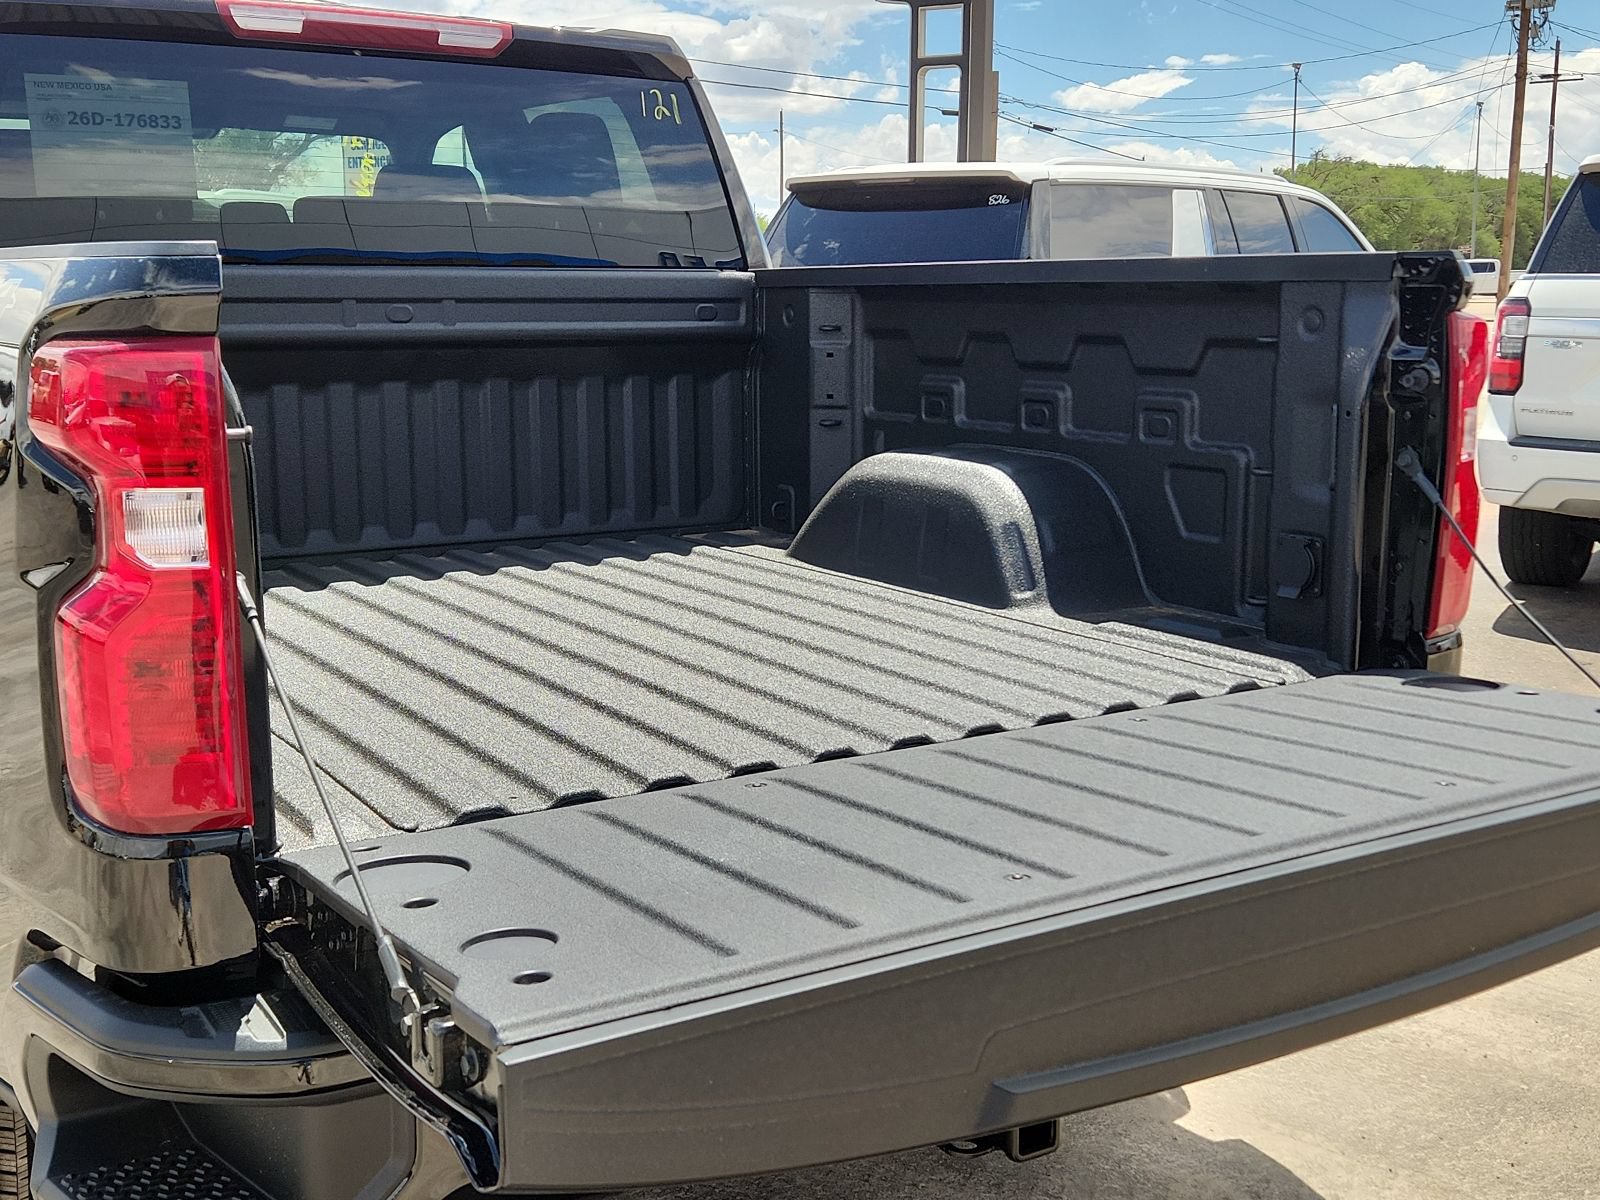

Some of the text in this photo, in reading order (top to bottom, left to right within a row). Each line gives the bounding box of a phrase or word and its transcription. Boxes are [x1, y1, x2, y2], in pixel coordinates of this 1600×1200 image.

[33, 80, 113, 92] NEW MEXICO USA
[641, 89, 682, 125] 121
[67, 110, 183, 130] 26D-176833
[350, 138, 387, 151] SRICE
[347, 155, 392, 169] ENTNCE
[988, 194, 1010, 206] 826
